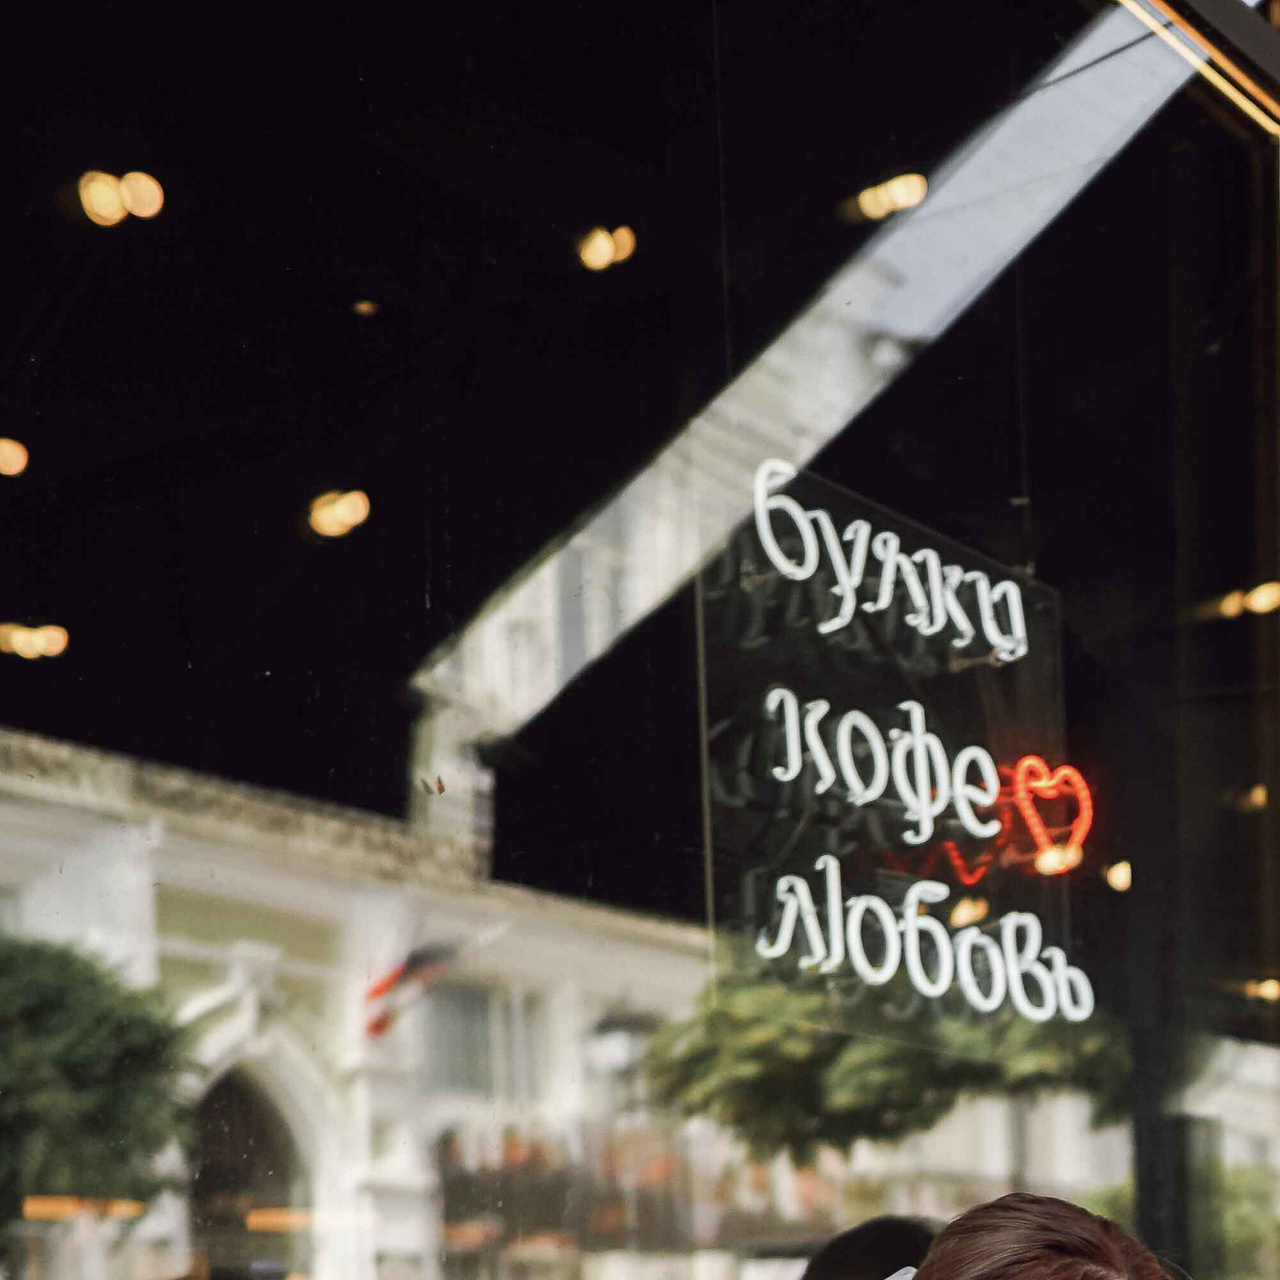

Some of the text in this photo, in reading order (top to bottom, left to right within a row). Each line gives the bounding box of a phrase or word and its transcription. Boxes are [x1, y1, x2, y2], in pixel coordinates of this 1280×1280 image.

[754, 458, 1028, 662] булки
[766, 688, 1000, 844] кофе
[755, 854, 1094, 1022] любовь
